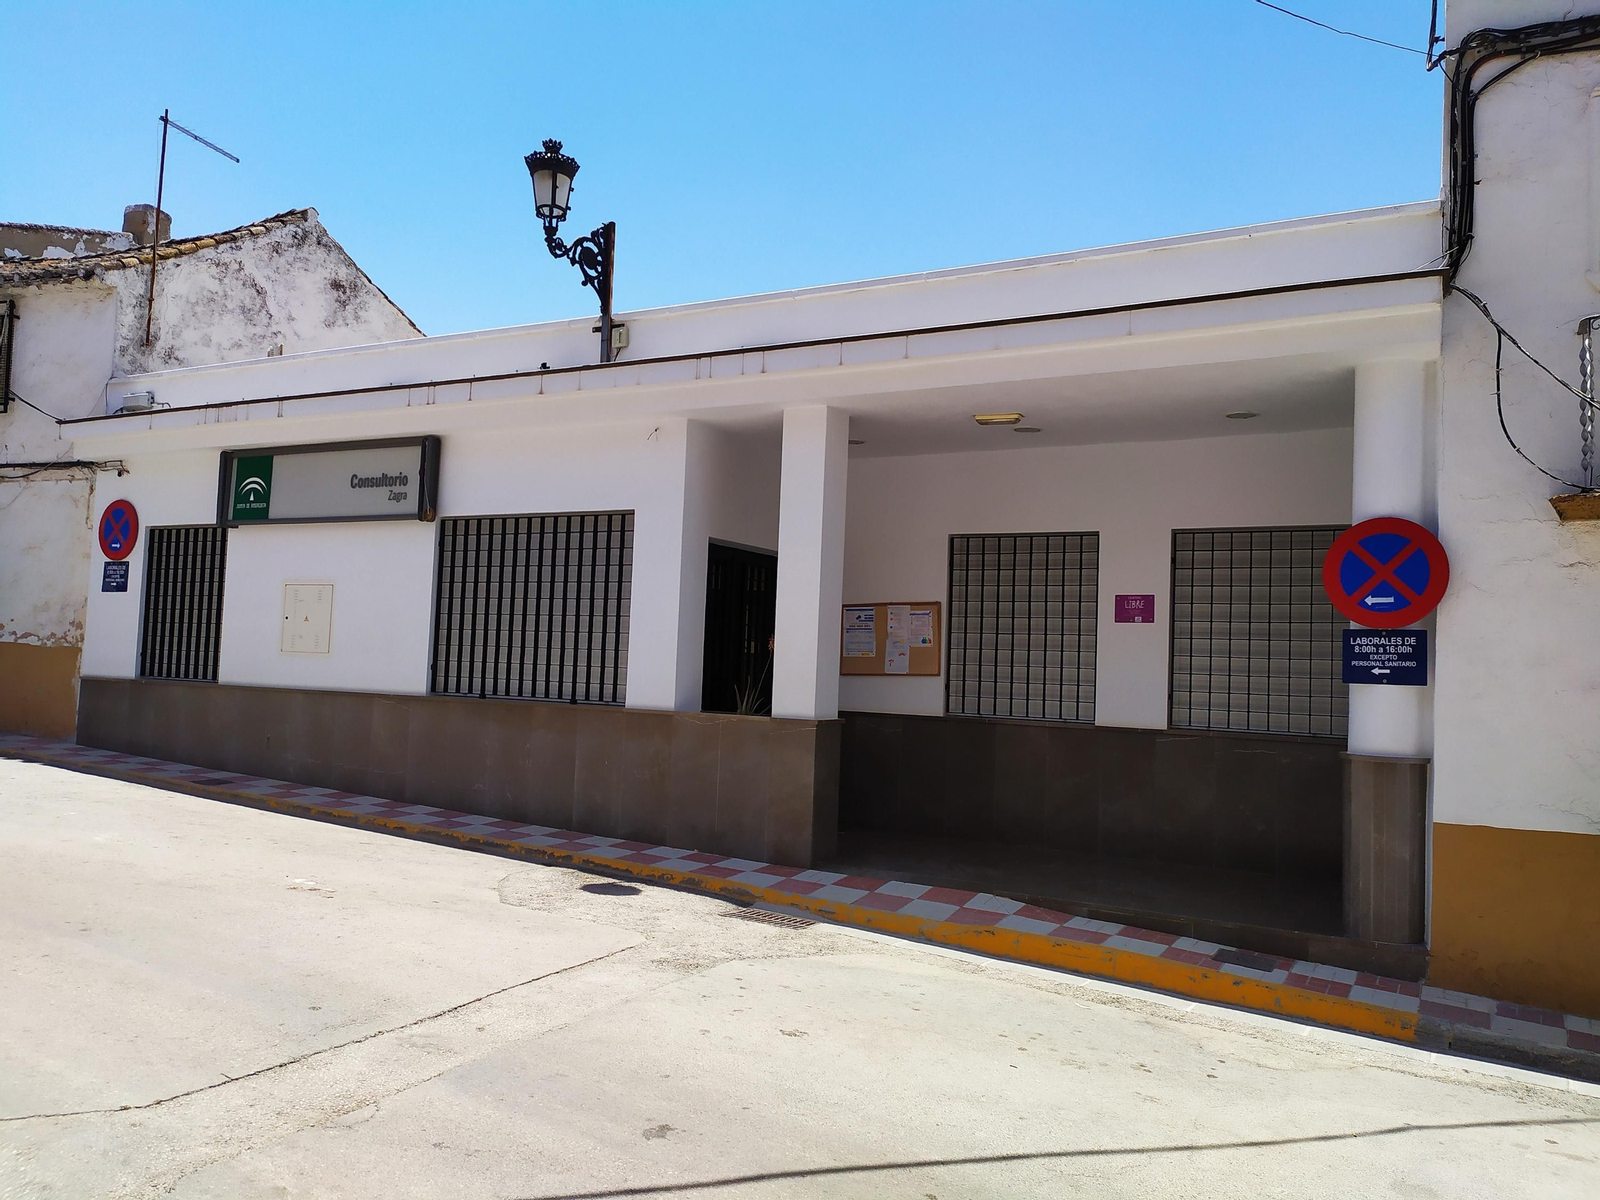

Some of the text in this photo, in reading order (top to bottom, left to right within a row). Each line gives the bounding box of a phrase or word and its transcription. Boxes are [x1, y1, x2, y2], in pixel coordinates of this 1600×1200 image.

[350, 472, 409, 489] Consultorio
[387, 490, 408, 503] Zagra
[1124, 600, 1145, 609] LIBRE
[1350, 637, 1417, 645] LABORALES DE
[1354, 645, 1377, 653] 8:00h
[1385, 645, 1413, 653] 16:00h
